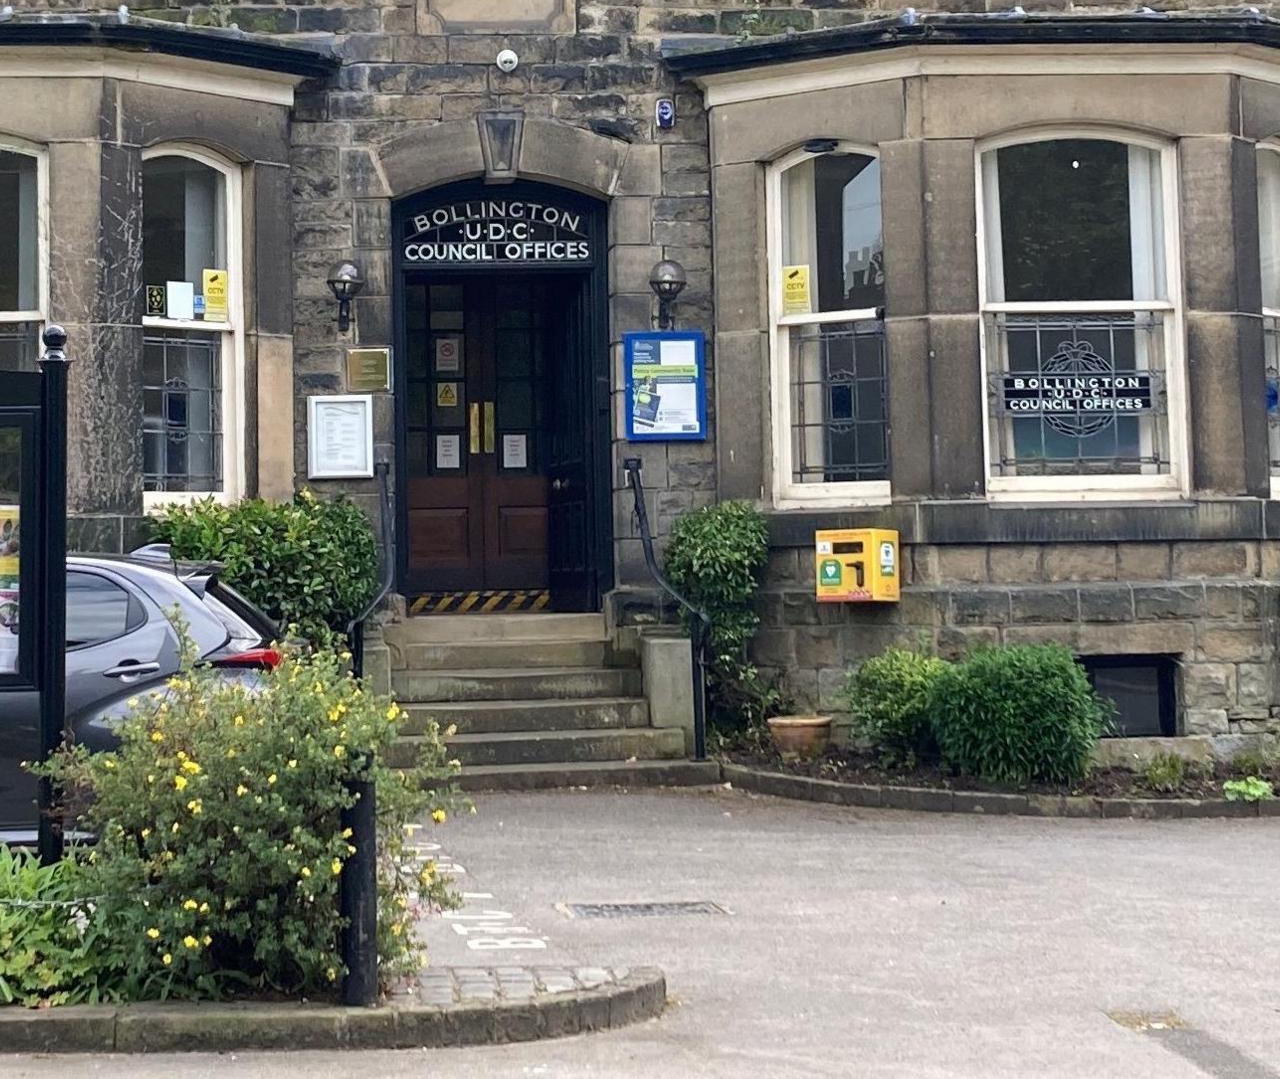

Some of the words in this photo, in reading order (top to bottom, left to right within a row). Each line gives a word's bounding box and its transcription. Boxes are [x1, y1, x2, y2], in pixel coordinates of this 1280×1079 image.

[413, 201, 580, 232] BOLLINGTON
[404, 244, 493, 260] COUNCIL
[504, 242, 590, 259] OFFICES
[787, 282, 805, 290] CCTV
[1014, 377, 1140, 389] BOLLINGTON
[1009, 399, 1074, 410] COUNCIL
[1083, 398, 1143, 409] OFFICES
